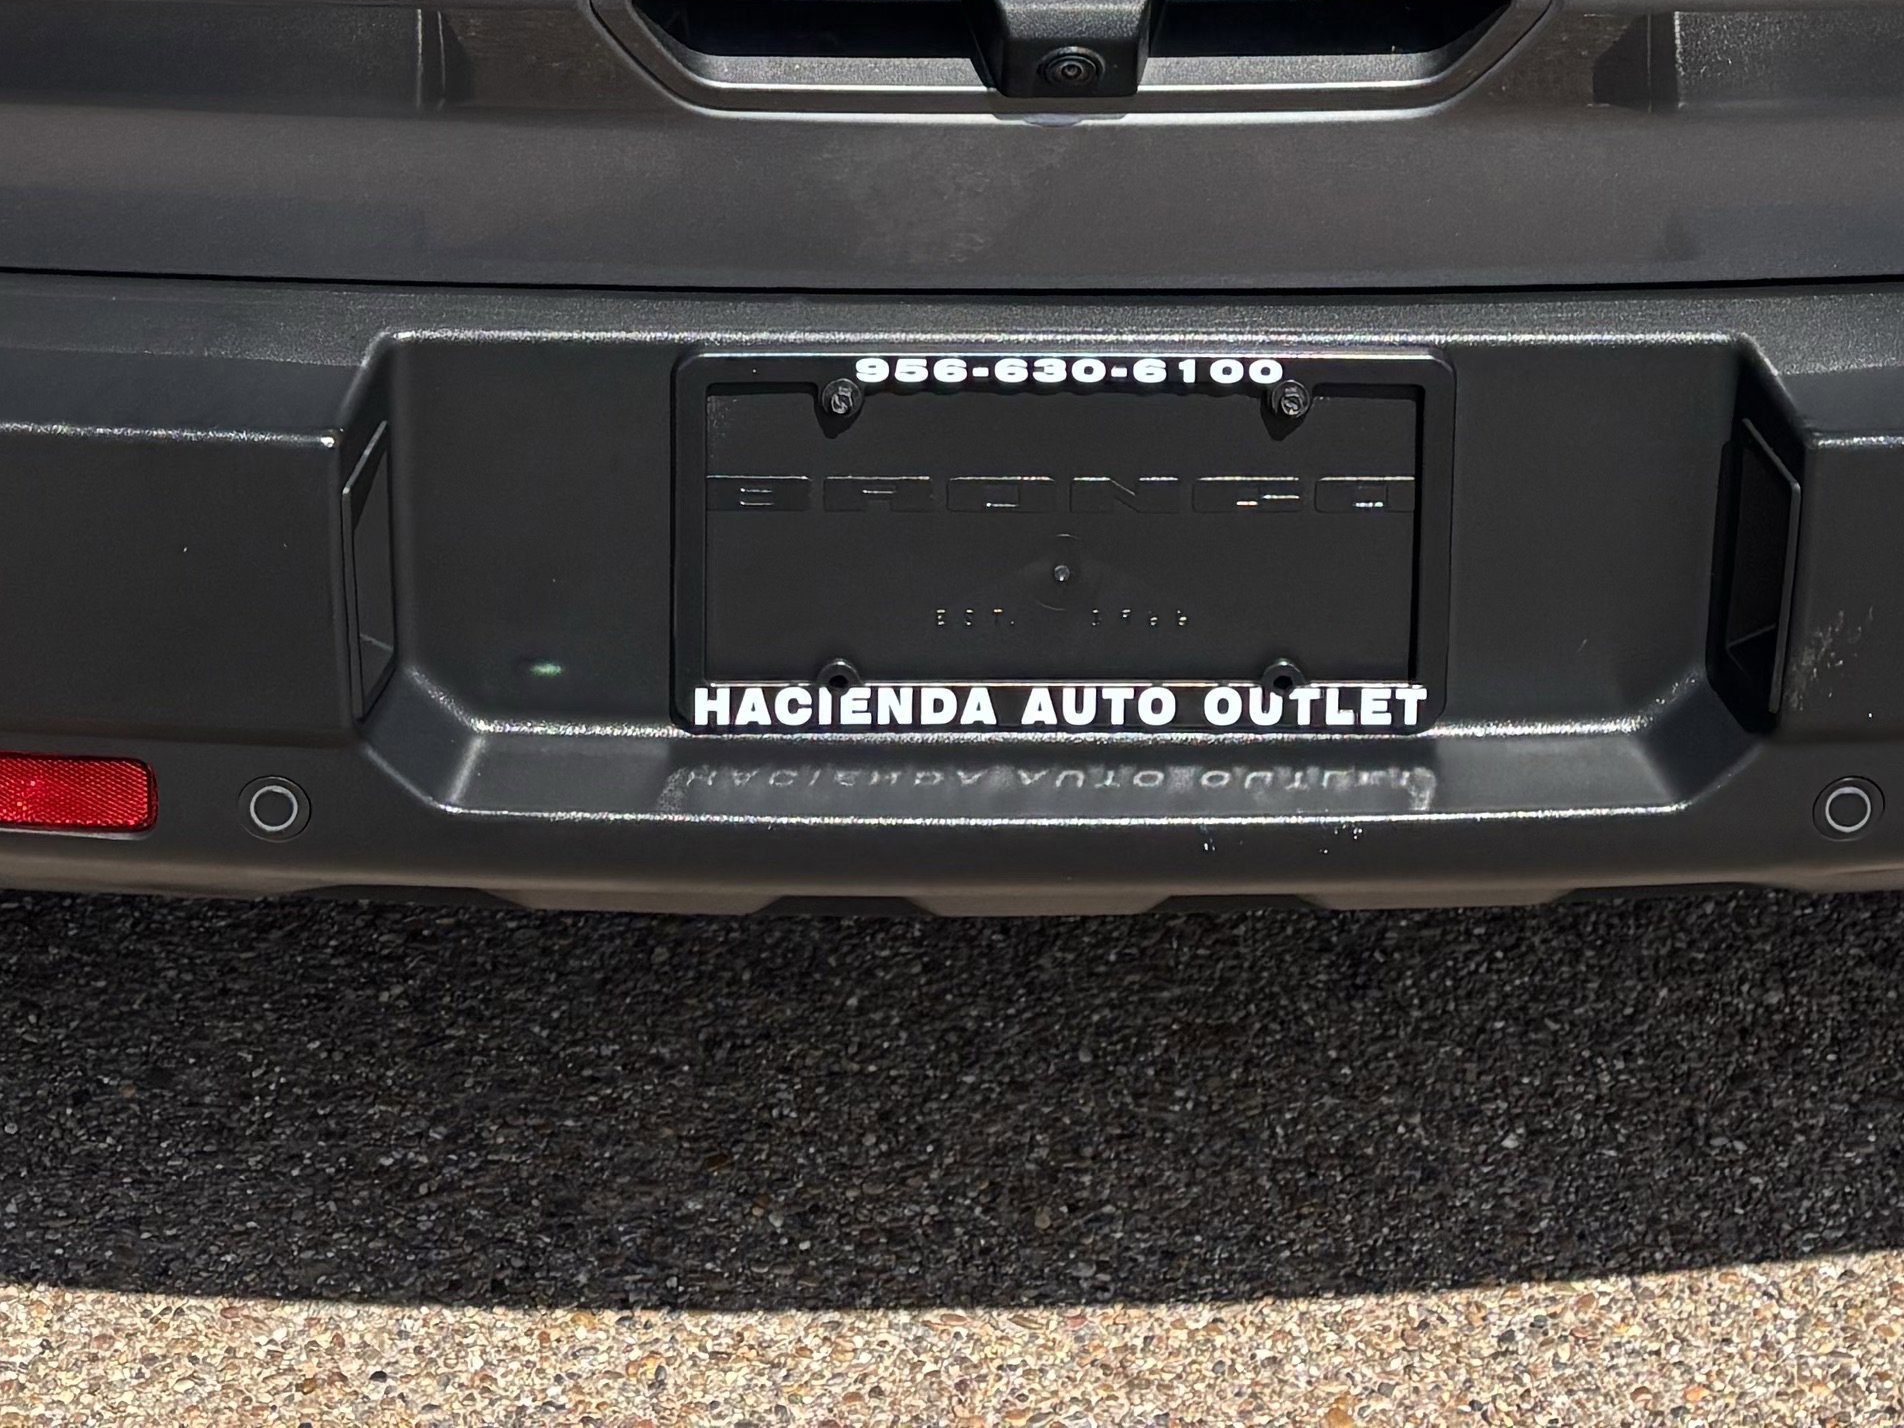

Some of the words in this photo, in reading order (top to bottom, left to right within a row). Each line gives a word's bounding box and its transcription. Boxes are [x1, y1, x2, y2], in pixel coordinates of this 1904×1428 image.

[855, 357, 1284, 384] 956-630-6100
[706, 474, 1415, 513] BRONCO
[695, 687, 998, 726] HACIENDA
[1021, 687, 1178, 726] AUTO
[1203, 687, 1428, 727] OUTLET
